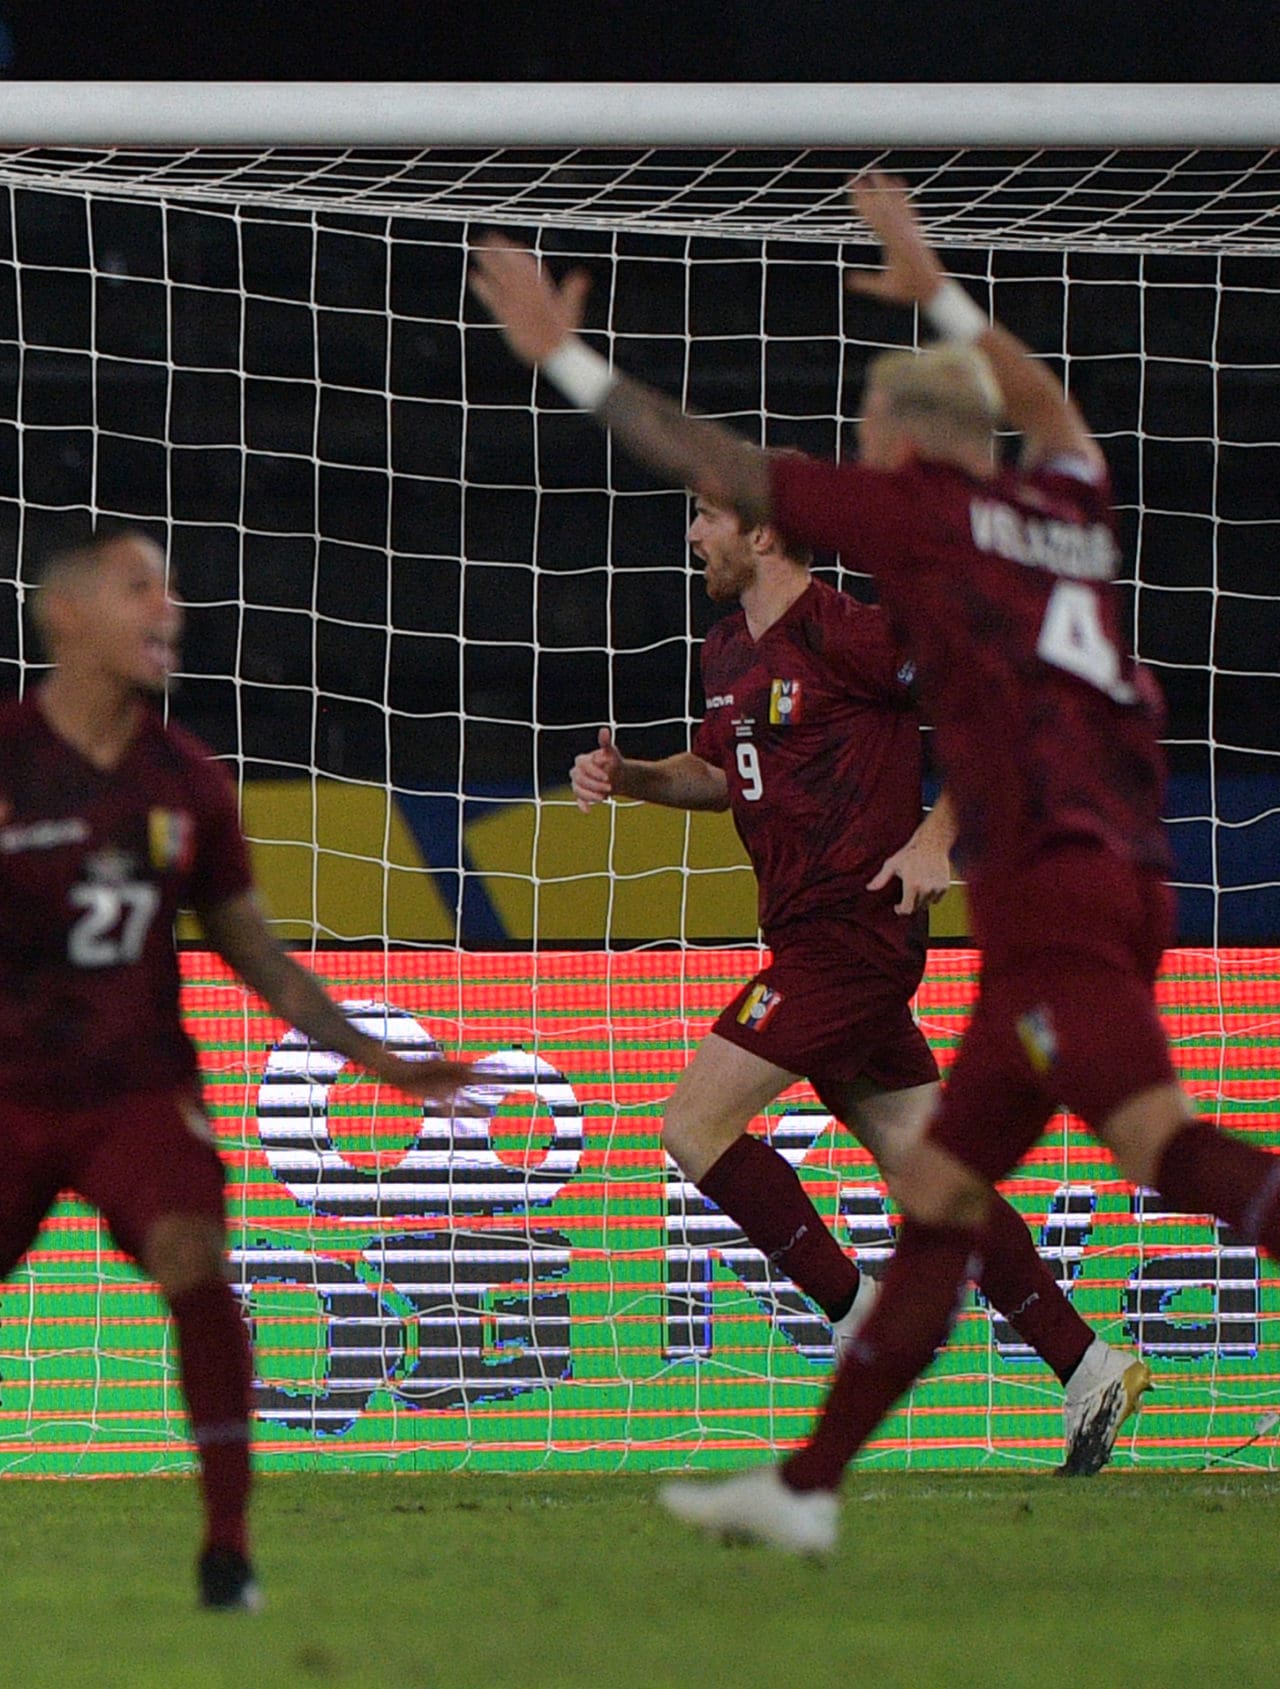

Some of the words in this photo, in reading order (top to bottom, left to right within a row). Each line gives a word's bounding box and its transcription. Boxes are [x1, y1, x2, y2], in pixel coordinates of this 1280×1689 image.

[1036, 578, 1138, 705] 4
[735, 743, 764, 801] 9
[67, 882, 163, 968] 27
